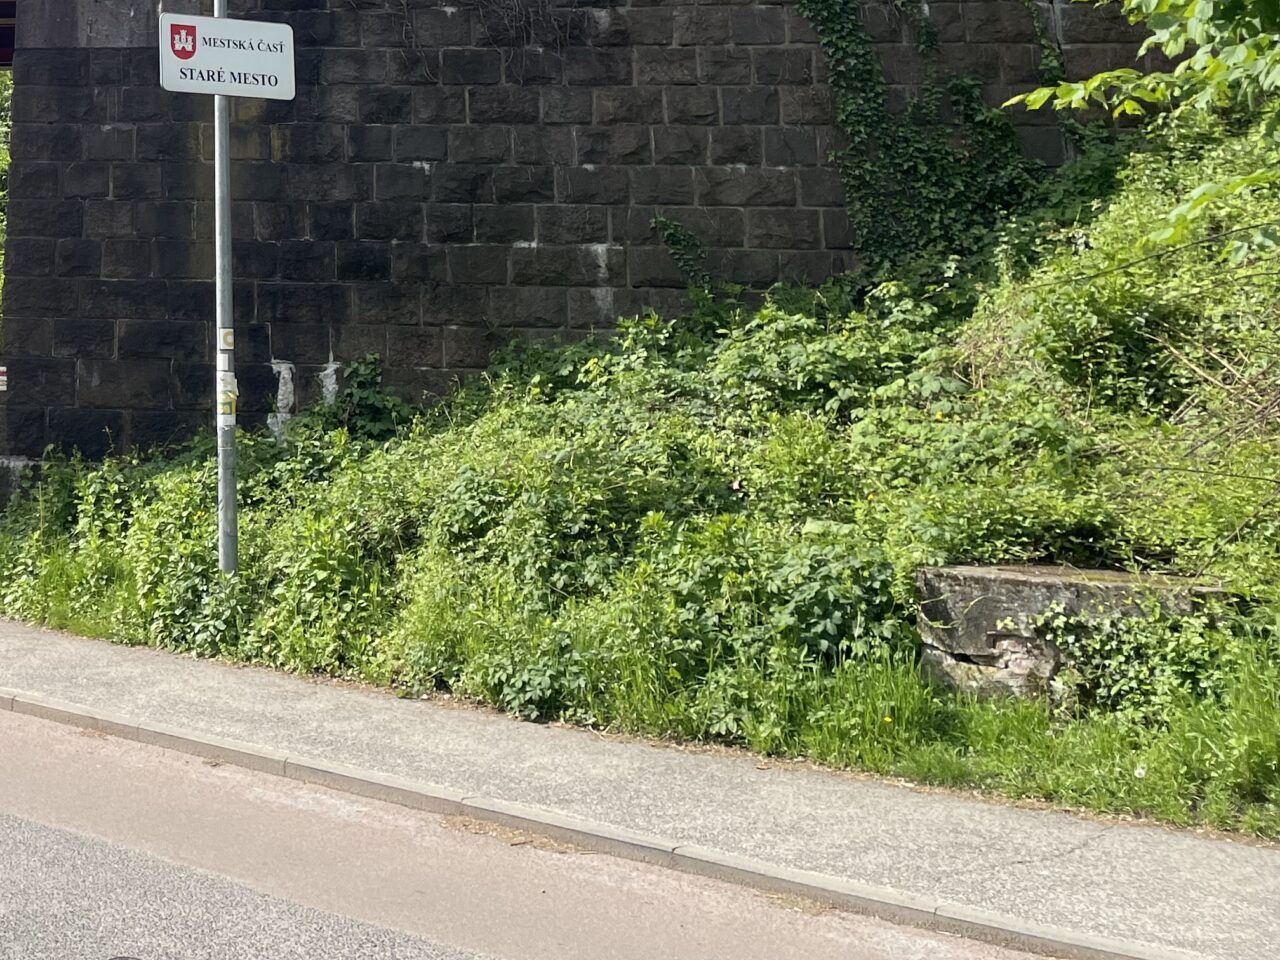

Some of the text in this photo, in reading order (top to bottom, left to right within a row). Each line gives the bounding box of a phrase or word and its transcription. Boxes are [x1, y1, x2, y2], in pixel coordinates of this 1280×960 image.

[202, 36, 286, 54] MESTSKÁ ČASŤ
[179, 67, 278, 87] STARÉ MESTO
